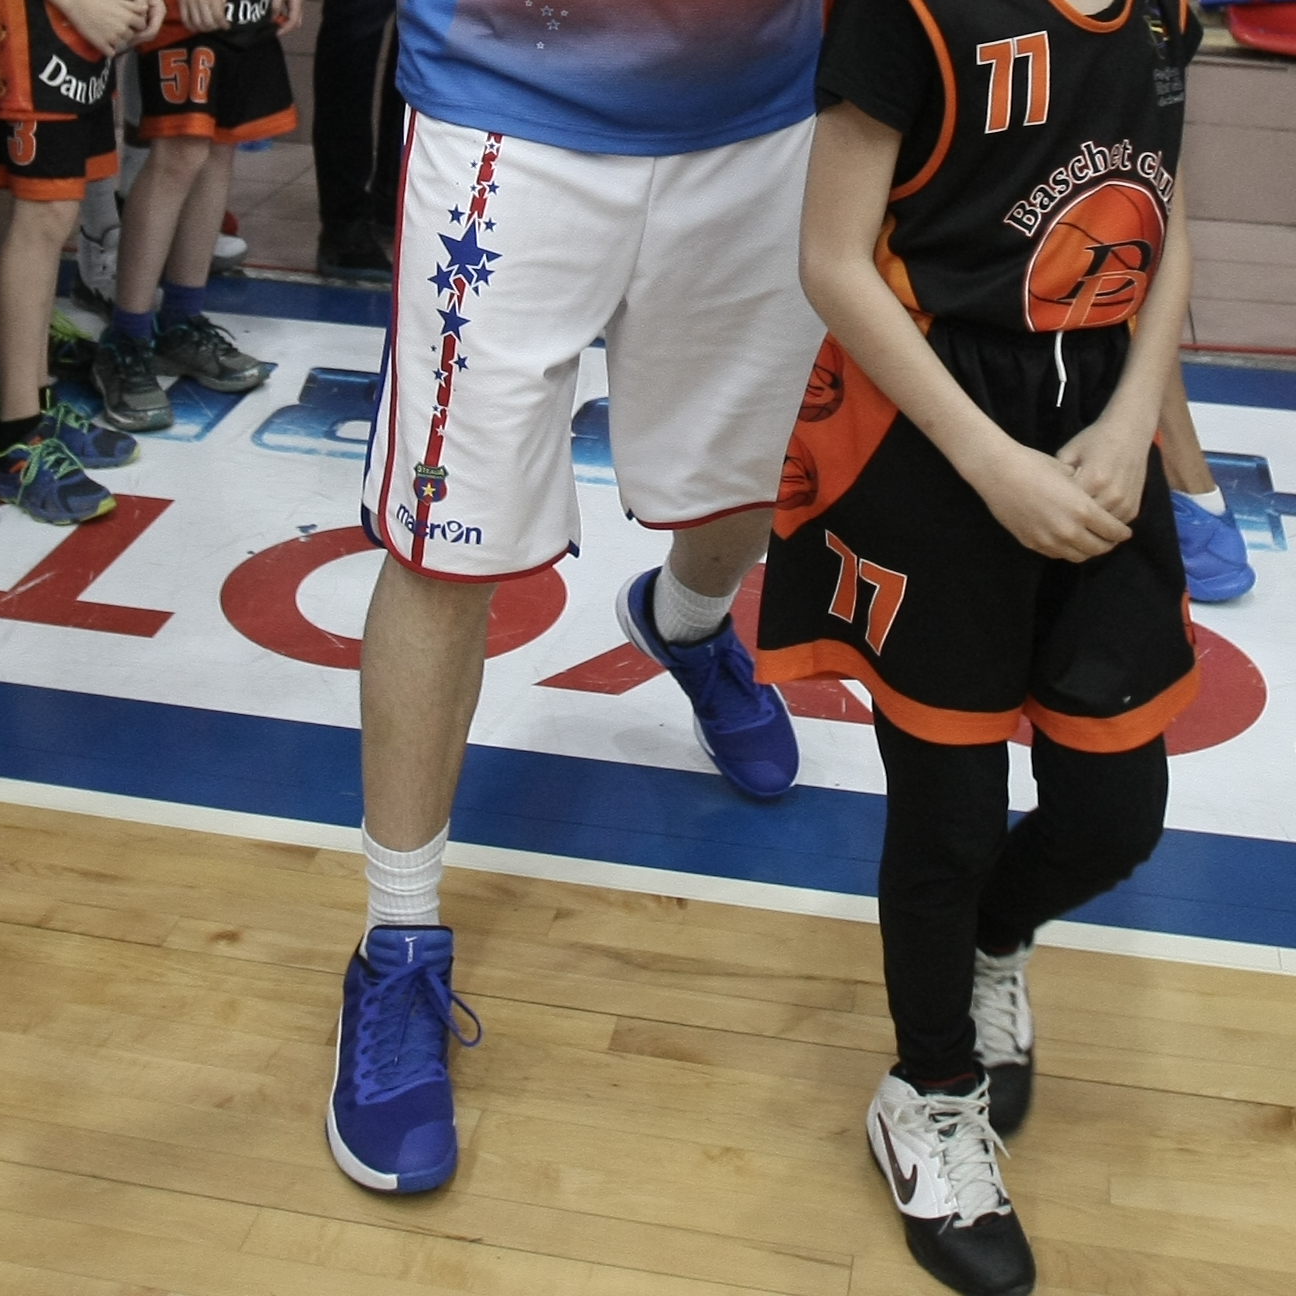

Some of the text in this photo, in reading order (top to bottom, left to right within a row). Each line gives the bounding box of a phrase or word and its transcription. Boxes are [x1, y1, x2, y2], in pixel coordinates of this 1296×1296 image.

[38, 54, 88, 105] Dan
[157, 46, 217, 105] 56
[1003, 138, 1133, 238] Baschet
[395, 503, 483, 545] macron
